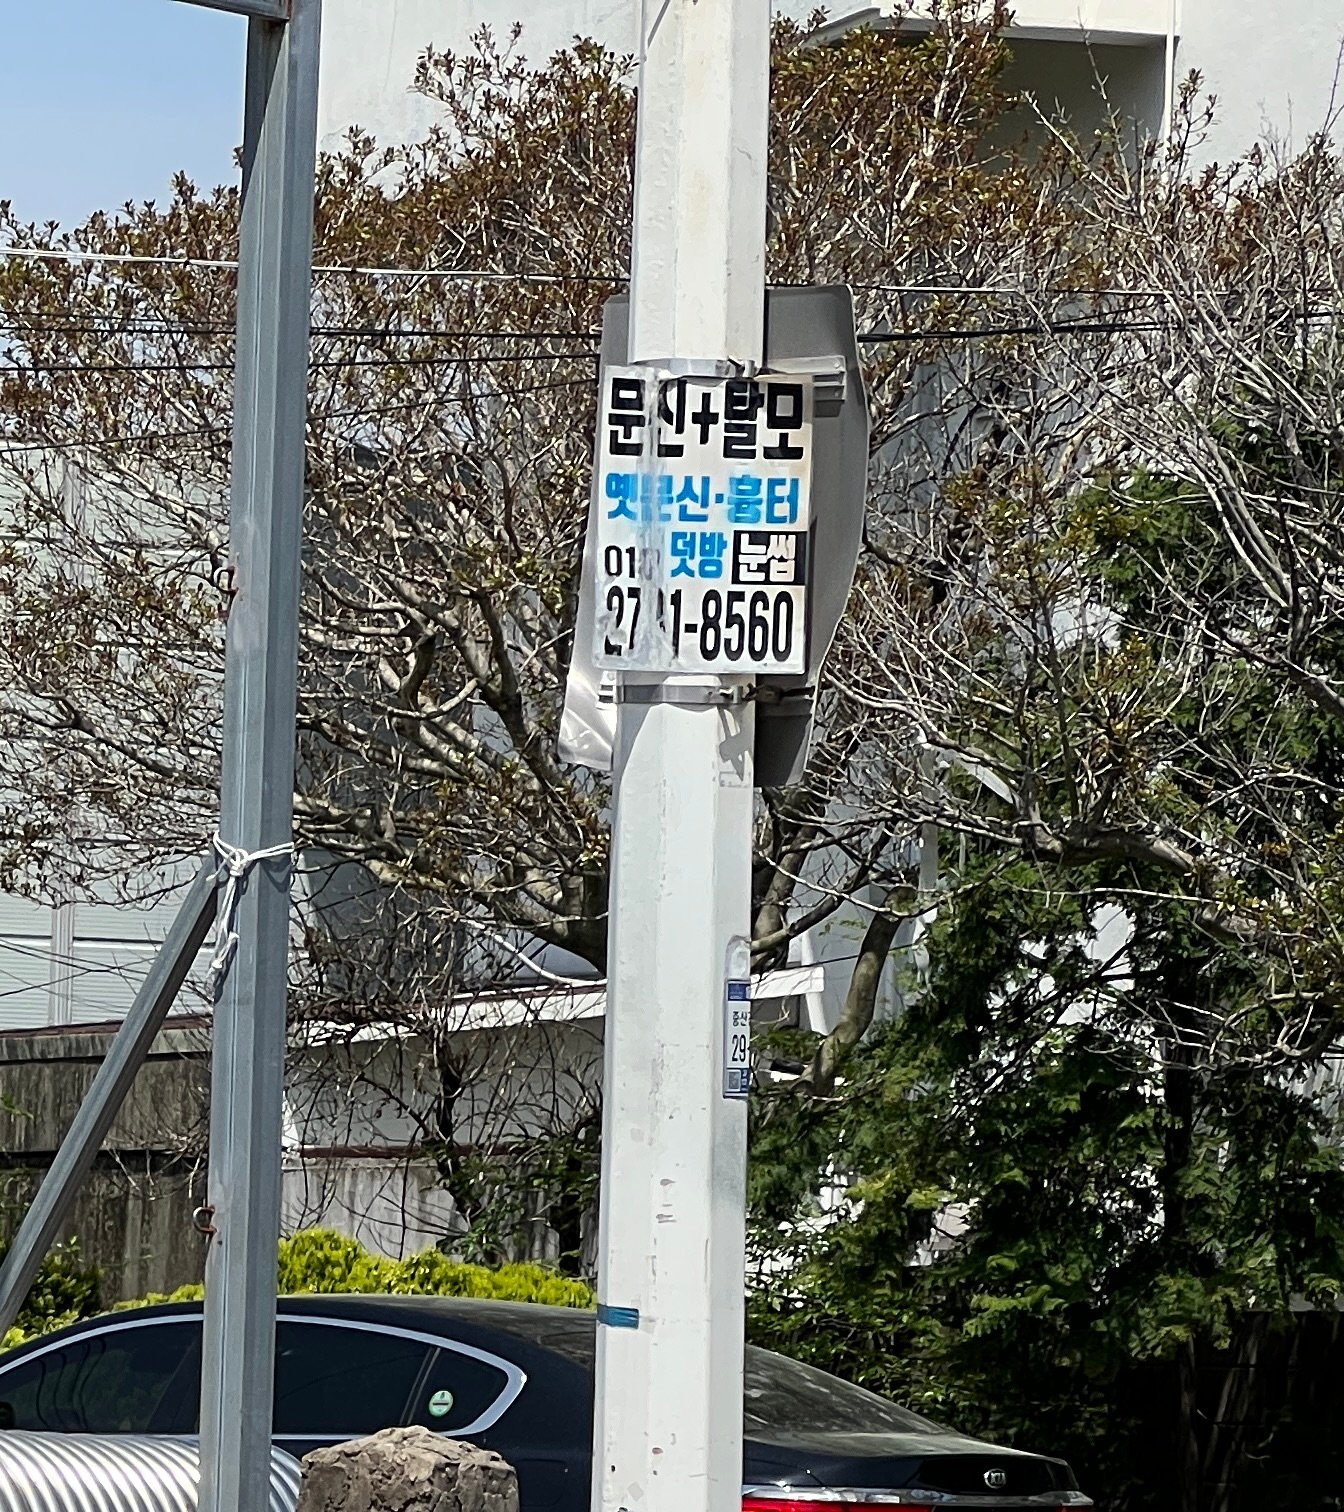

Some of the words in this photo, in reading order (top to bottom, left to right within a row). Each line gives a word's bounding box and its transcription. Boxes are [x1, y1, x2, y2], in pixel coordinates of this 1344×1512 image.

[738, 533, 797, 582] 눈썹
[604, 585, 794, 662] 271-8560
[731, 1034, 747, 1062] 29
